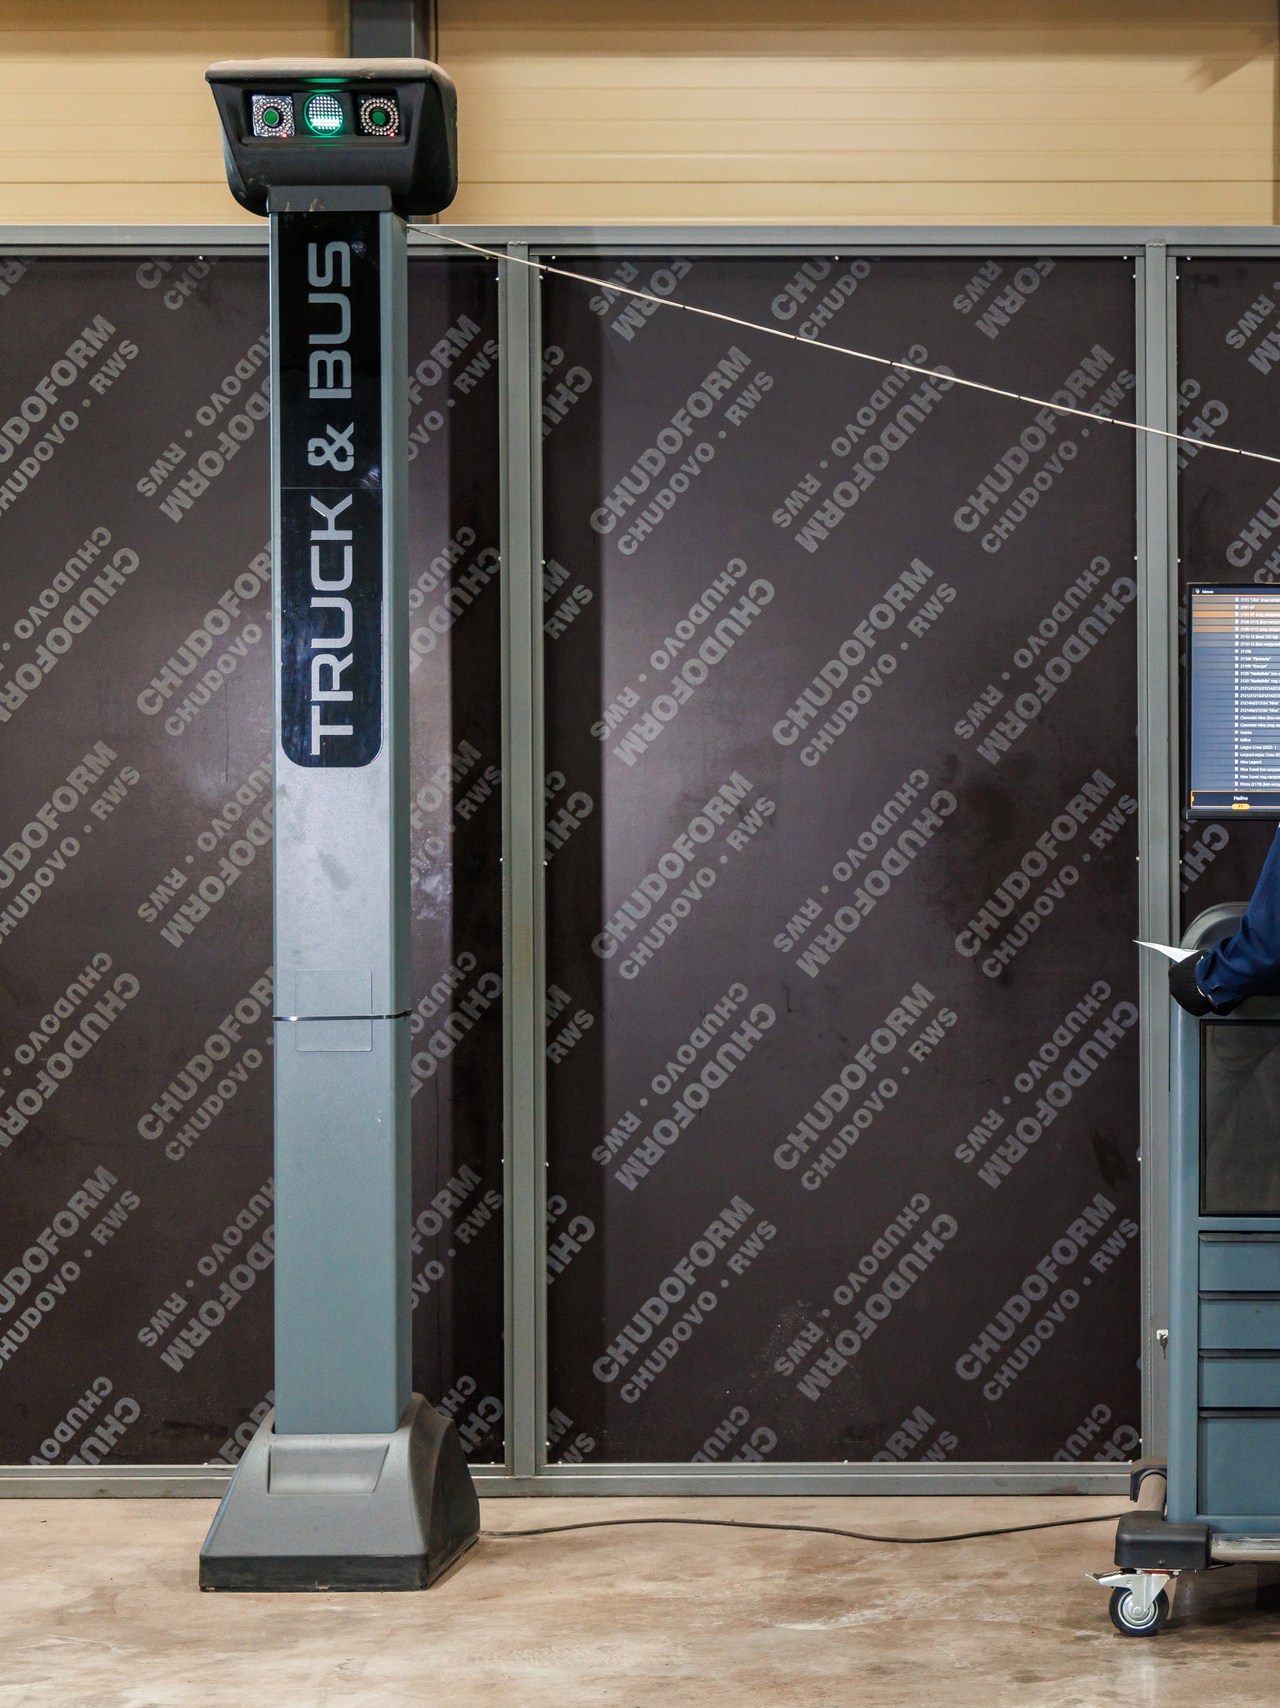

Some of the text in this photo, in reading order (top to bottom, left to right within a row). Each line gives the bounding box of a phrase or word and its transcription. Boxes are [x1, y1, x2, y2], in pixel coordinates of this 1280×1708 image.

[454, 340, 501, 394] RWS
[799, 257, 881, 340] CHUDO
[953, 259, 1002, 313] RWS
[1226, 295, 1275, 349] RWS
[0, 340, 138, 517] HUDOVO RWS
[137, 442, 186, 496] RWS
[308, 241, 355, 756] TRUCK & BUS
[590, 346, 751, 533] CHUDOFORM
[618, 372, 774, 554] CHUDOVO RWS
[772, 345, 928, 527] CHUDOVO RWS
[795, 366, 956, 553] CHUDOFORM
[953, 344, 1114, 531] CHUDOFORM
[981, 370, 1137, 552] CHUDOVO RWS
[0, 548, 139, 729] CHUDOFOR
[14, 527, 111, 638] CHUDOVO
[137, 540, 272, 714] CHUDOFOR
[410, 527, 476, 616] CHUDO
[544, 585, 593, 639] RWS
[591, 558, 747, 740] CHUDOVO RWS
[772, 558, 933, 745] CHUDOFORM
[954, 557, 1110, 739] CHUDOVO RWS
[165, 624, 262, 735] CHUDOVO
[614, 579, 775, 766] CHUDOFORM
[800, 584, 956, 766] CHUDOVO RWS
[977, 578, 1137, 765] CHUDOFORM
[0, 766, 139, 944] HUDOVO RWS
[455, 766, 503, 820] RWS
[591, 771, 752, 958] CHUDOFORM
[773, 770, 929, 952] CHUDOVO RWS
[954, 769, 1115, 956] CHUDOFORM
[138, 868, 187, 922] RWS
[619, 797, 775, 979] CHUDOVO RWS
[796, 791, 957, 978] CHUDOFORM
[982, 795, 1138, 977] CHUDOVO RWS
[0, 974, 140, 1157] CHUDOFOR
[15, 953, 112, 1064] CHUDOVO
[138, 965, 274, 1139] CHUDOFOR
[545, 1010, 594, 1064] RWS
[592, 983, 748, 1165] CHUDOVO RWS
[615, 1004, 776, 1191] CHUDOFORM
[773, 982, 934, 1169] CHUDOFORM
[801, 1008, 957, 1190] CHUDOVO RWS
[955, 981, 1111, 1163] CHUDOVO RWS
[978, 1002, 1139, 1189] CHUDOFORM
[166, 1049, 263, 1160] CHUDOVO
[0, 1191, 140, 1371] HUDOVO RWS
[138, 1177, 274, 1346] HUDOVO RWS
[455, 1190, 504, 1244] RWS
[593, 1195, 754, 1382] CHUDOFORM
[774, 1194, 930, 1376] CHUDOVO RWS
[955, 1193, 1116, 1380] CHUDOFORM
[621, 1221, 777, 1403] CHUDOVO RWS
[797, 1215, 958, 1402] CHUDOFORM
[983, 1219, 1139, 1401] CHUDOVO RWS
[557, 1433, 595, 1463] WS
[920, 1431, 958, 1463] WS
[1053, 1404, 1111, 1463] CHUD
